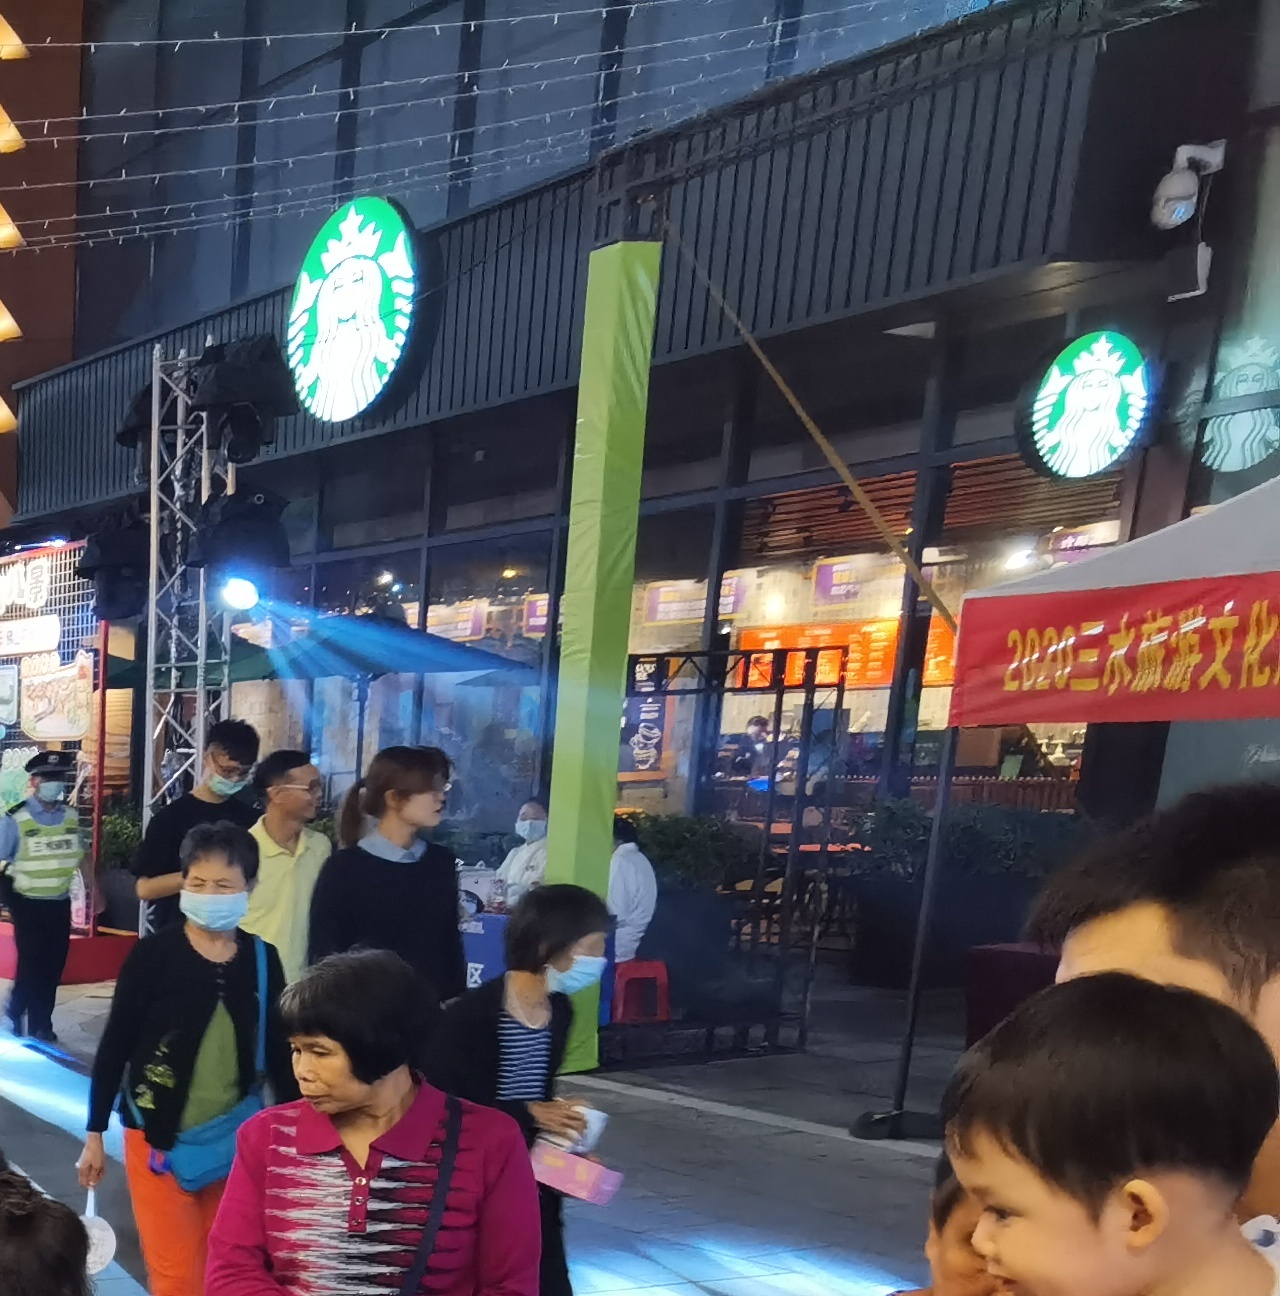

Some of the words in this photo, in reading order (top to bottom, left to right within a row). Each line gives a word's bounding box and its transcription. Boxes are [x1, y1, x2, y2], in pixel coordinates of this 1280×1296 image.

[1002, 599, 1280, 696] 2020三水旅游文化
